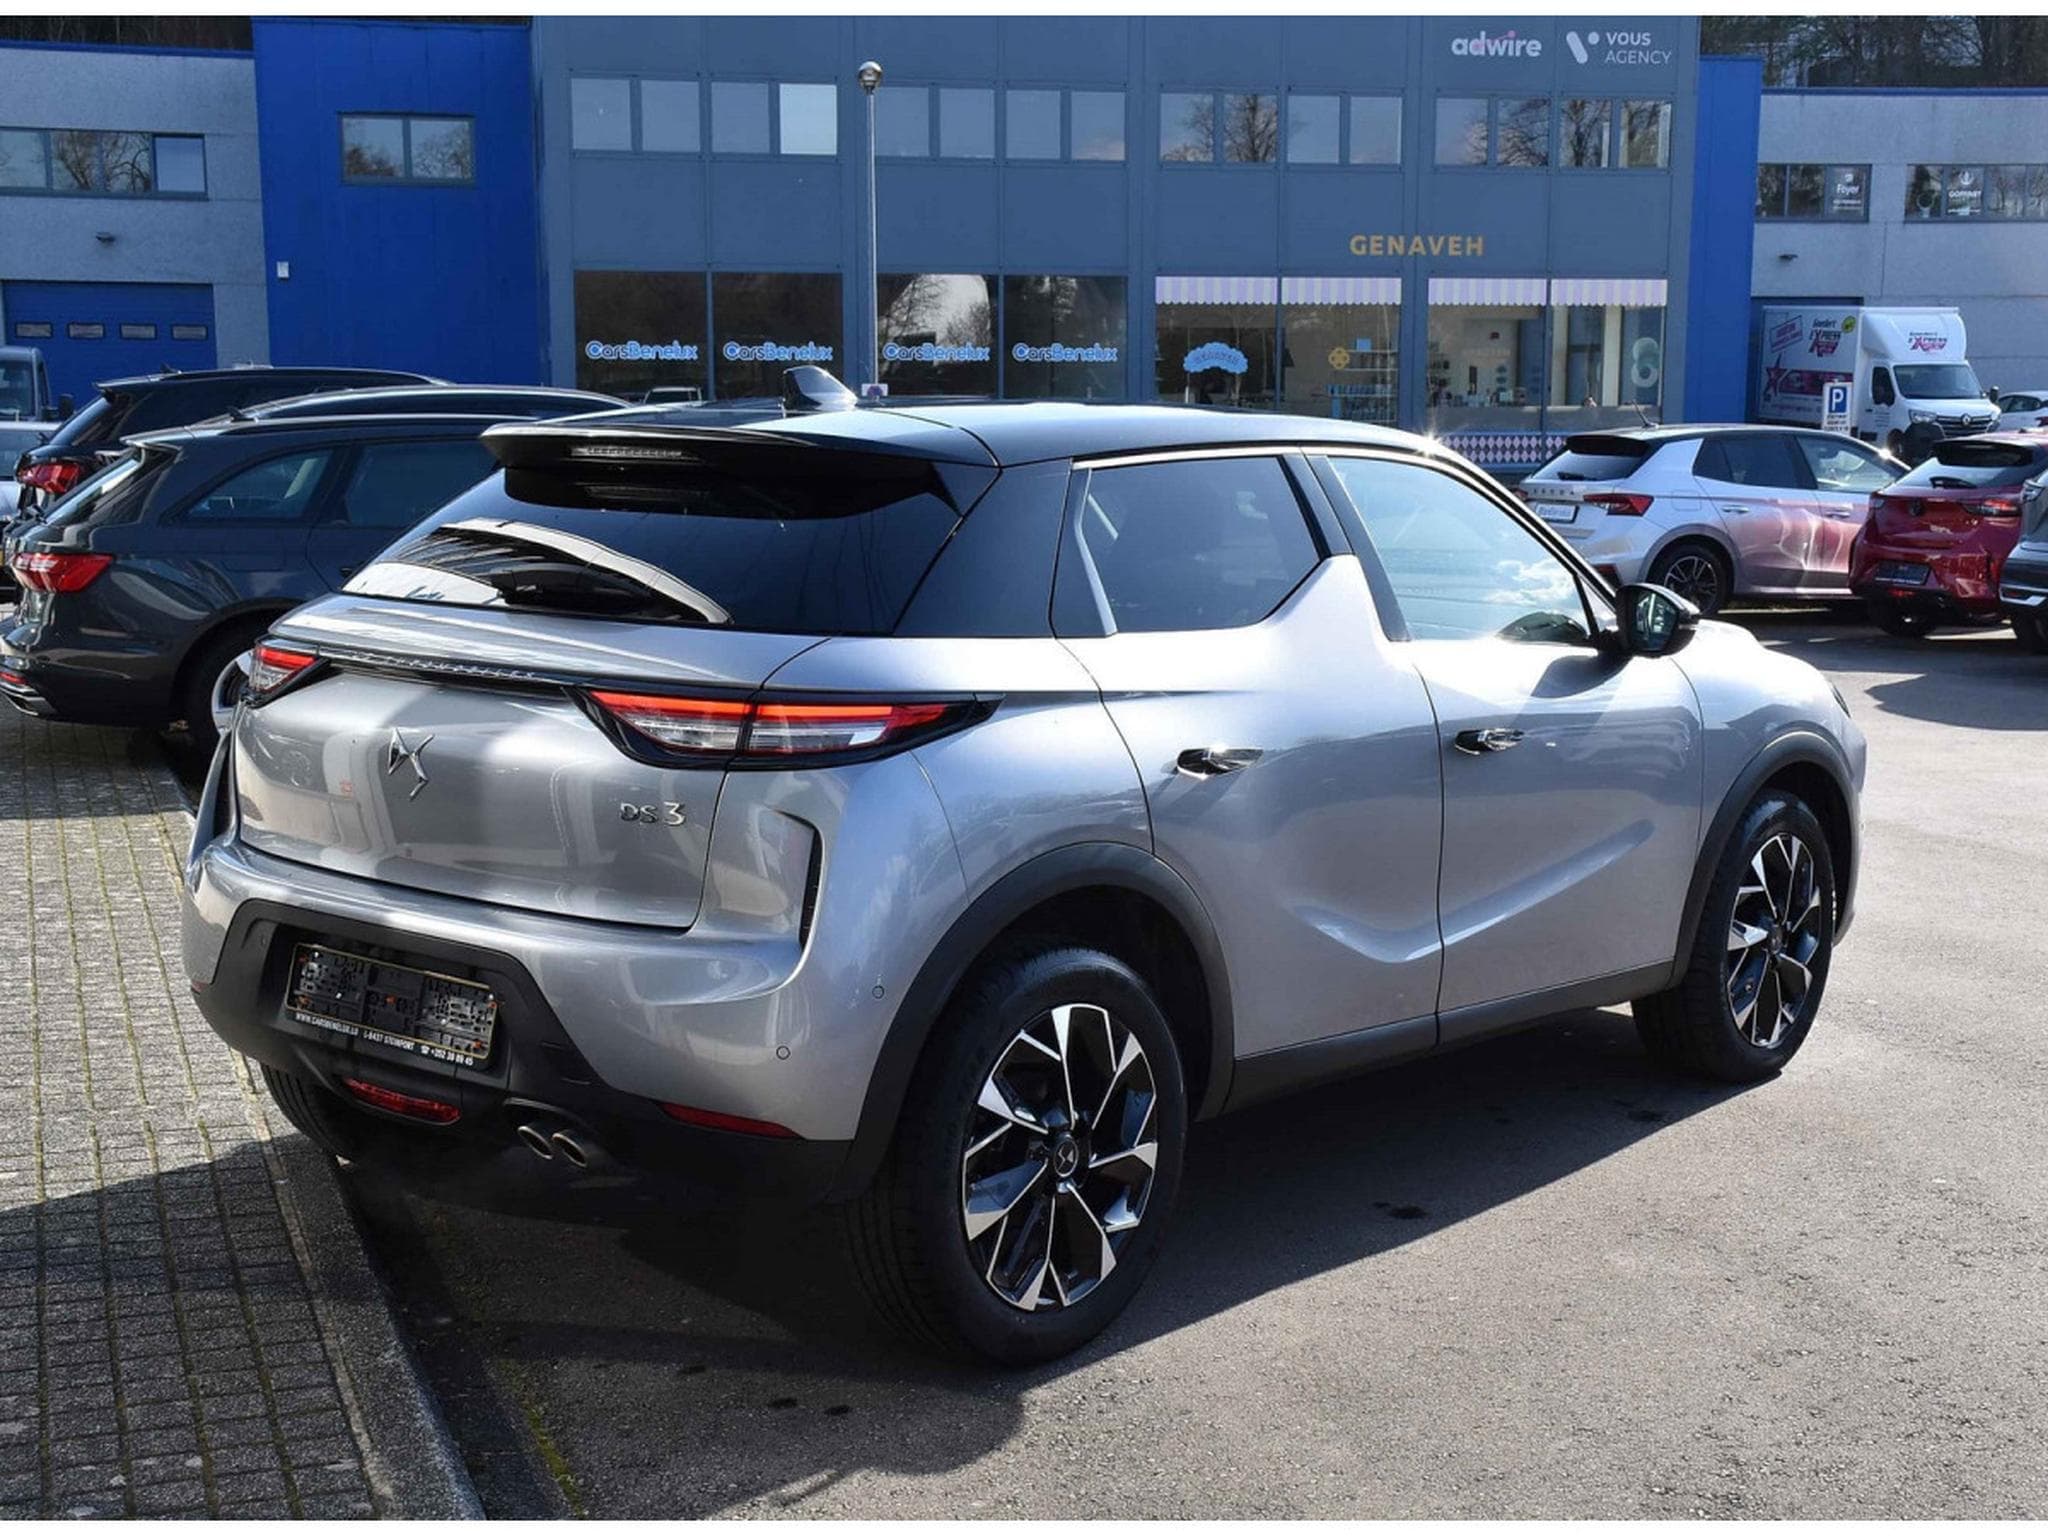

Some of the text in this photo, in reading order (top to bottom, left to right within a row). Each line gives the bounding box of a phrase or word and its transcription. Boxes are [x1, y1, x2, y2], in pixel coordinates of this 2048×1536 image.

[1451, 31, 1542, 57] adwire
[1605, 32, 1652, 46] VOUS
[1605, 51, 1672, 64] AGENCY
[1837, 184, 1860, 195] Foyer
[1349, 234, 1484, 256] GENAVEH
[586, 340, 698, 360] CarsBenelux
[723, 342, 834, 361] CarsBenelux
[883, 343, 991, 362] CarsBenelux
[1012, 343, 1118, 362] CarsBenelux
[1831, 388, 1844, 412] P
[619, 800, 687, 828] DS 3
